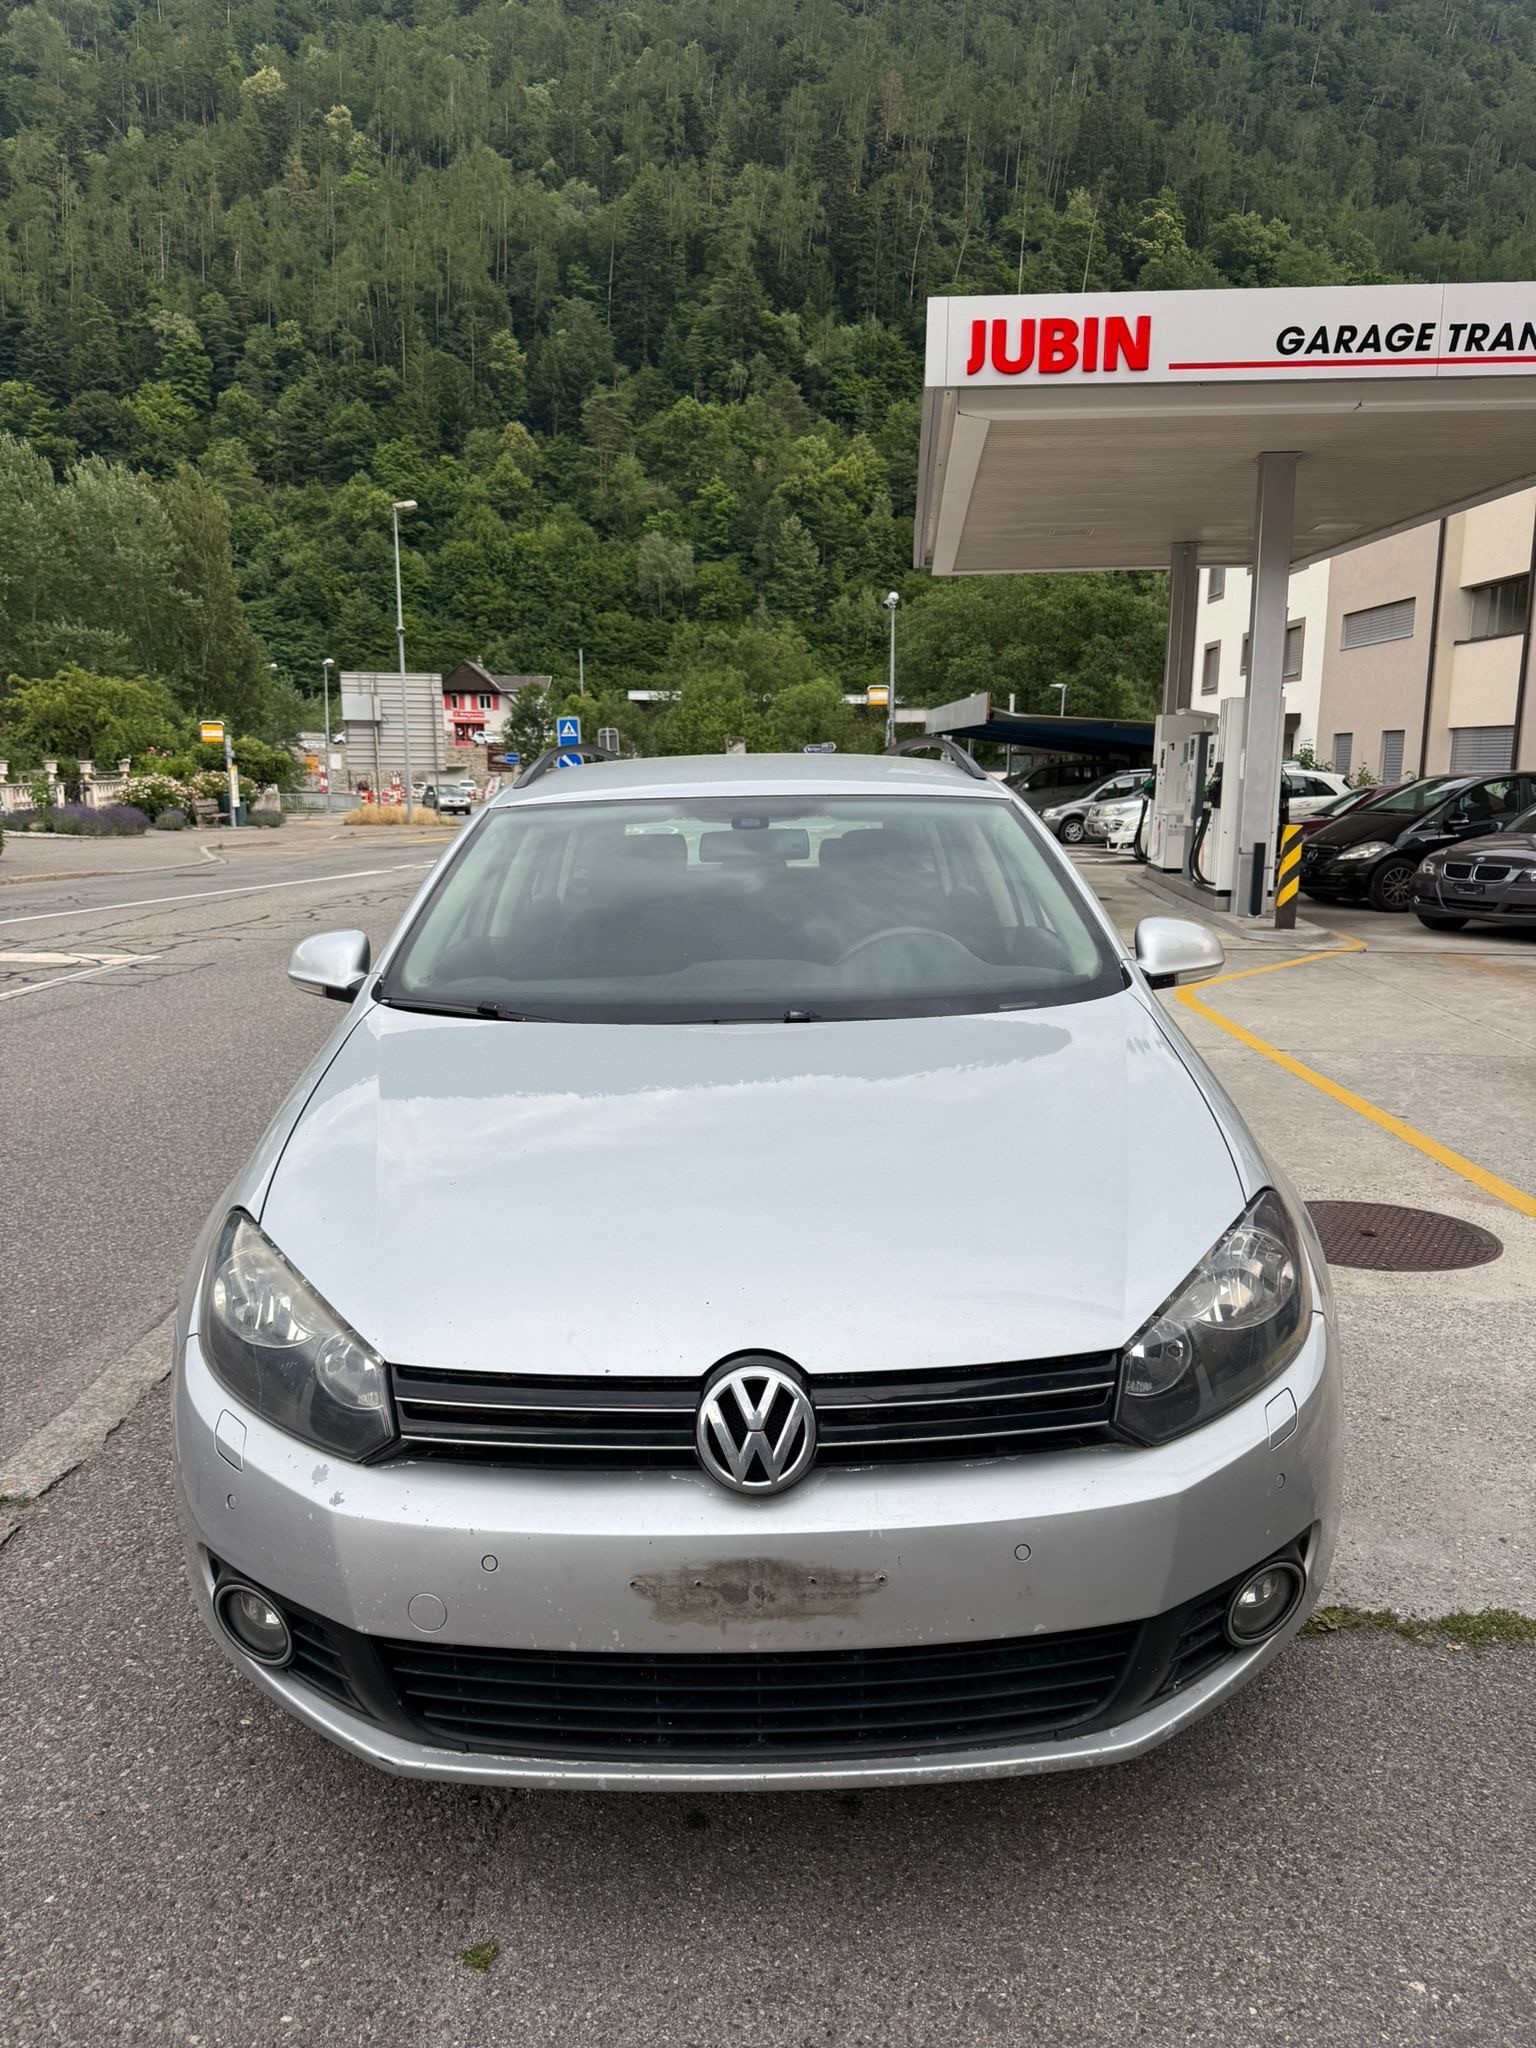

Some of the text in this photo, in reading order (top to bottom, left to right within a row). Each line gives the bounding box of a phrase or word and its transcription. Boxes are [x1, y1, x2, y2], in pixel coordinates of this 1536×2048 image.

[967, 316, 1152, 376] JUBIN
[1277, 322, 1437, 356] GARAGE
[702, 1371, 808, 1487] VW
